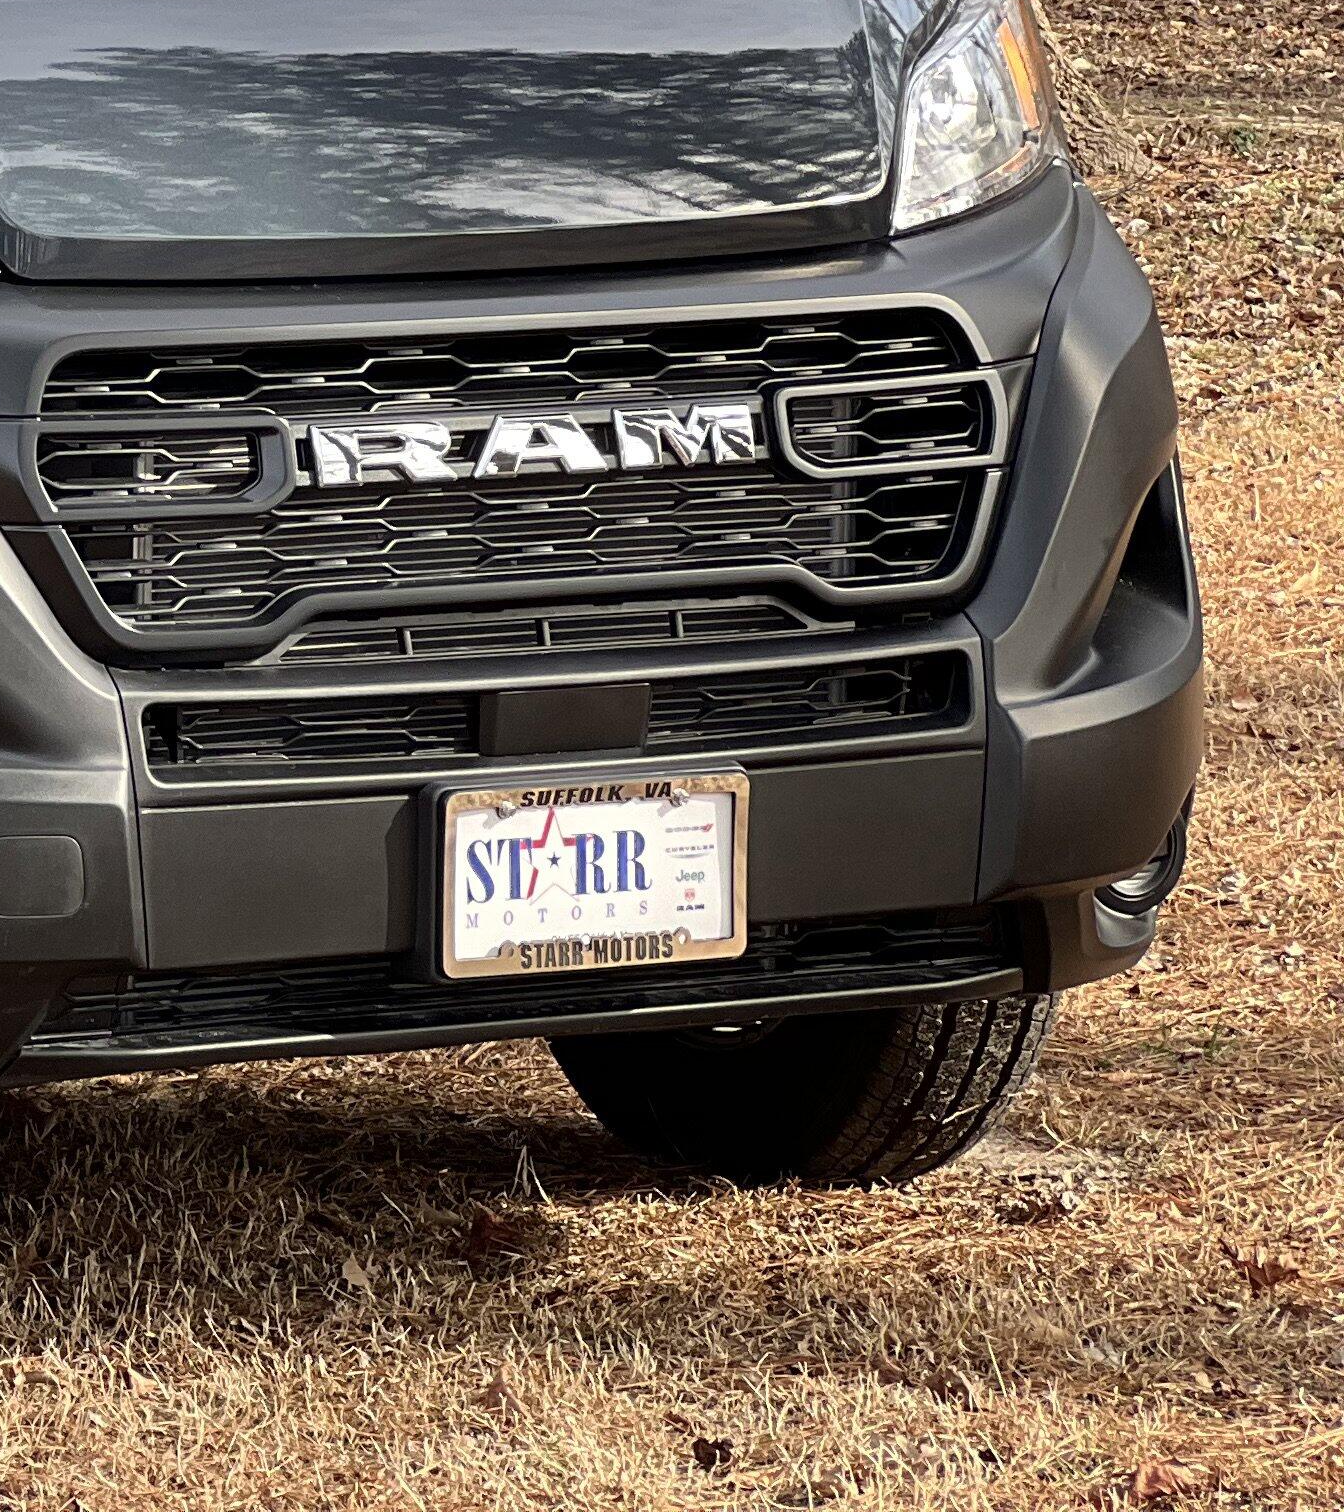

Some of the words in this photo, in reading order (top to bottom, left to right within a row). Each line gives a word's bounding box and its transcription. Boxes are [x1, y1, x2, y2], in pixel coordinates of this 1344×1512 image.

[309, 404, 754, 487] RAM
[645, 782, 672, 799] VA
[675, 868, 706, 884] Jeep
[465, 899, 649, 930] MOTORS
[676, 903, 706, 913] RAM
[520, 937, 585, 970] STARR
[592, 934, 674, 965] MOTORS
